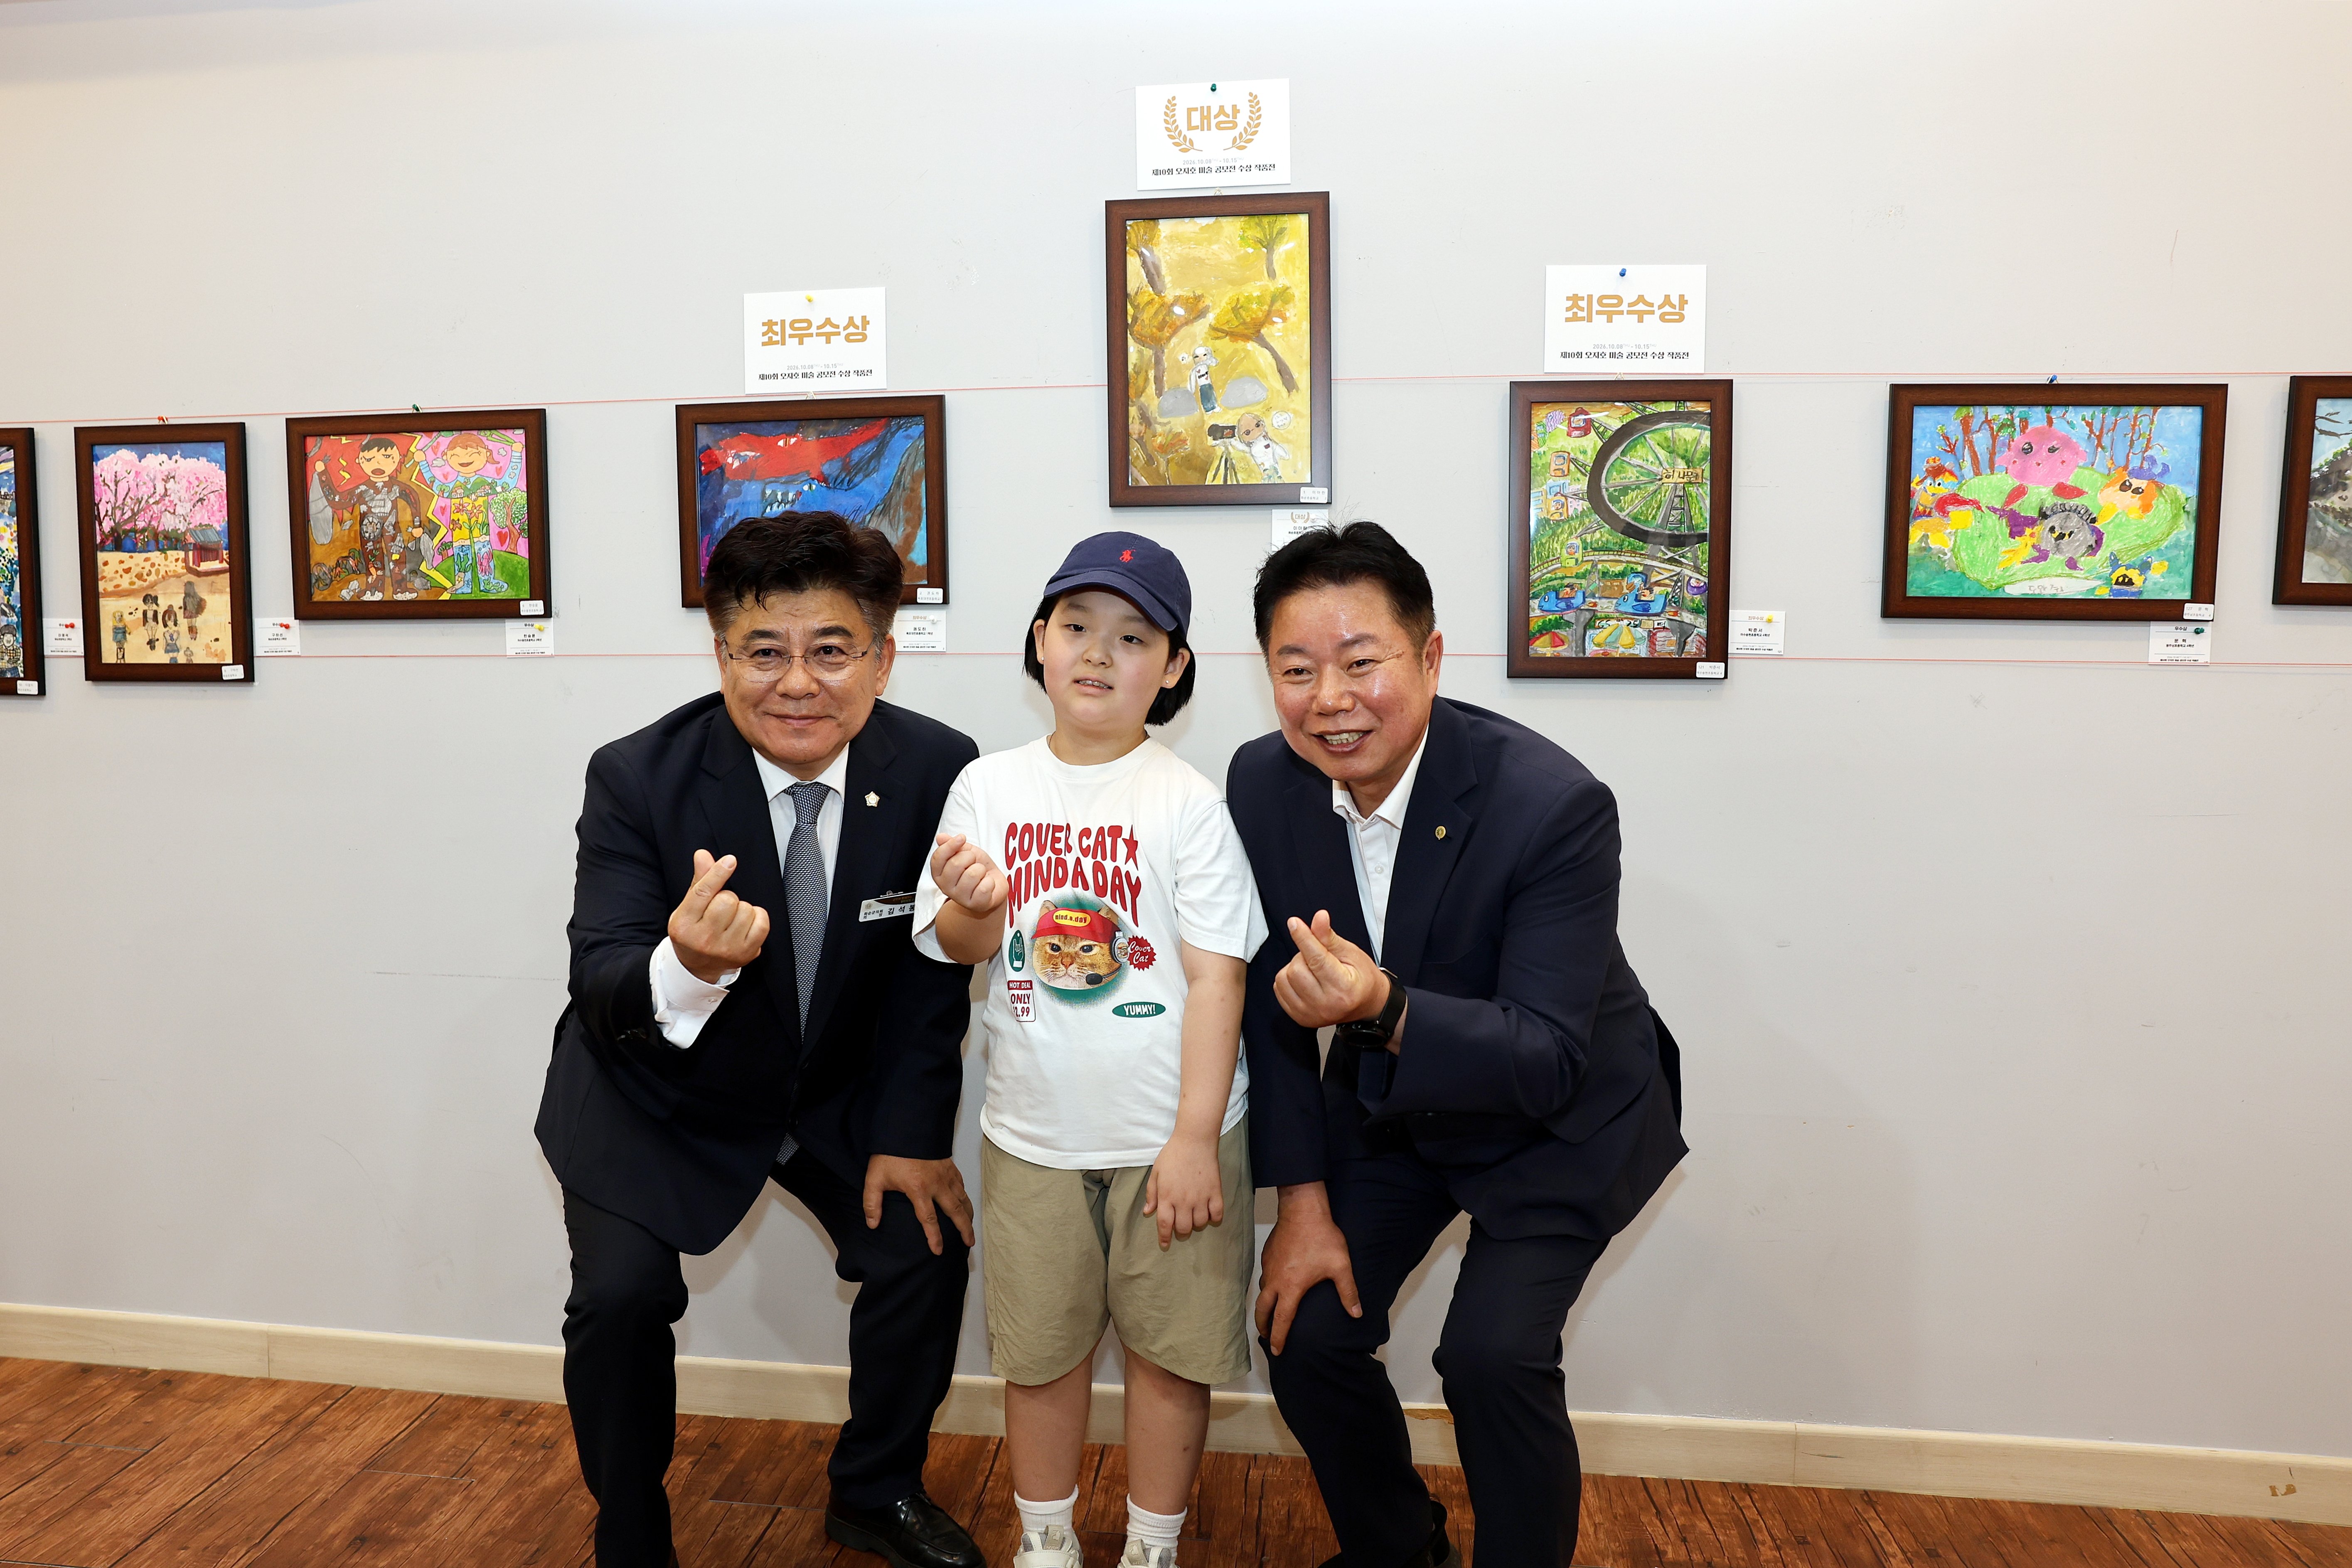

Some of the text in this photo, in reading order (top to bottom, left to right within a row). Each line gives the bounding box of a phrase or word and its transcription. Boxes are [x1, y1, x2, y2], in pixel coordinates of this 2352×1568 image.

[1187, 104, 1240, 131] 대상
[1565, 293, 1688, 323] 최우수상
[761, 315, 870, 347] 최우수상
[1005, 822, 1122, 870] COVER CAT
[1007, 856, 1142, 928] MIND A DAY
[1055, 914, 1087, 923] mind.a.day
[1129, 941, 1151, 953] Cover
[1133, 952, 1149, 964] Cat
[1011, 993, 1030, 1004] ONLY
[1124, 1004, 1156, 1016] YUMMY!
